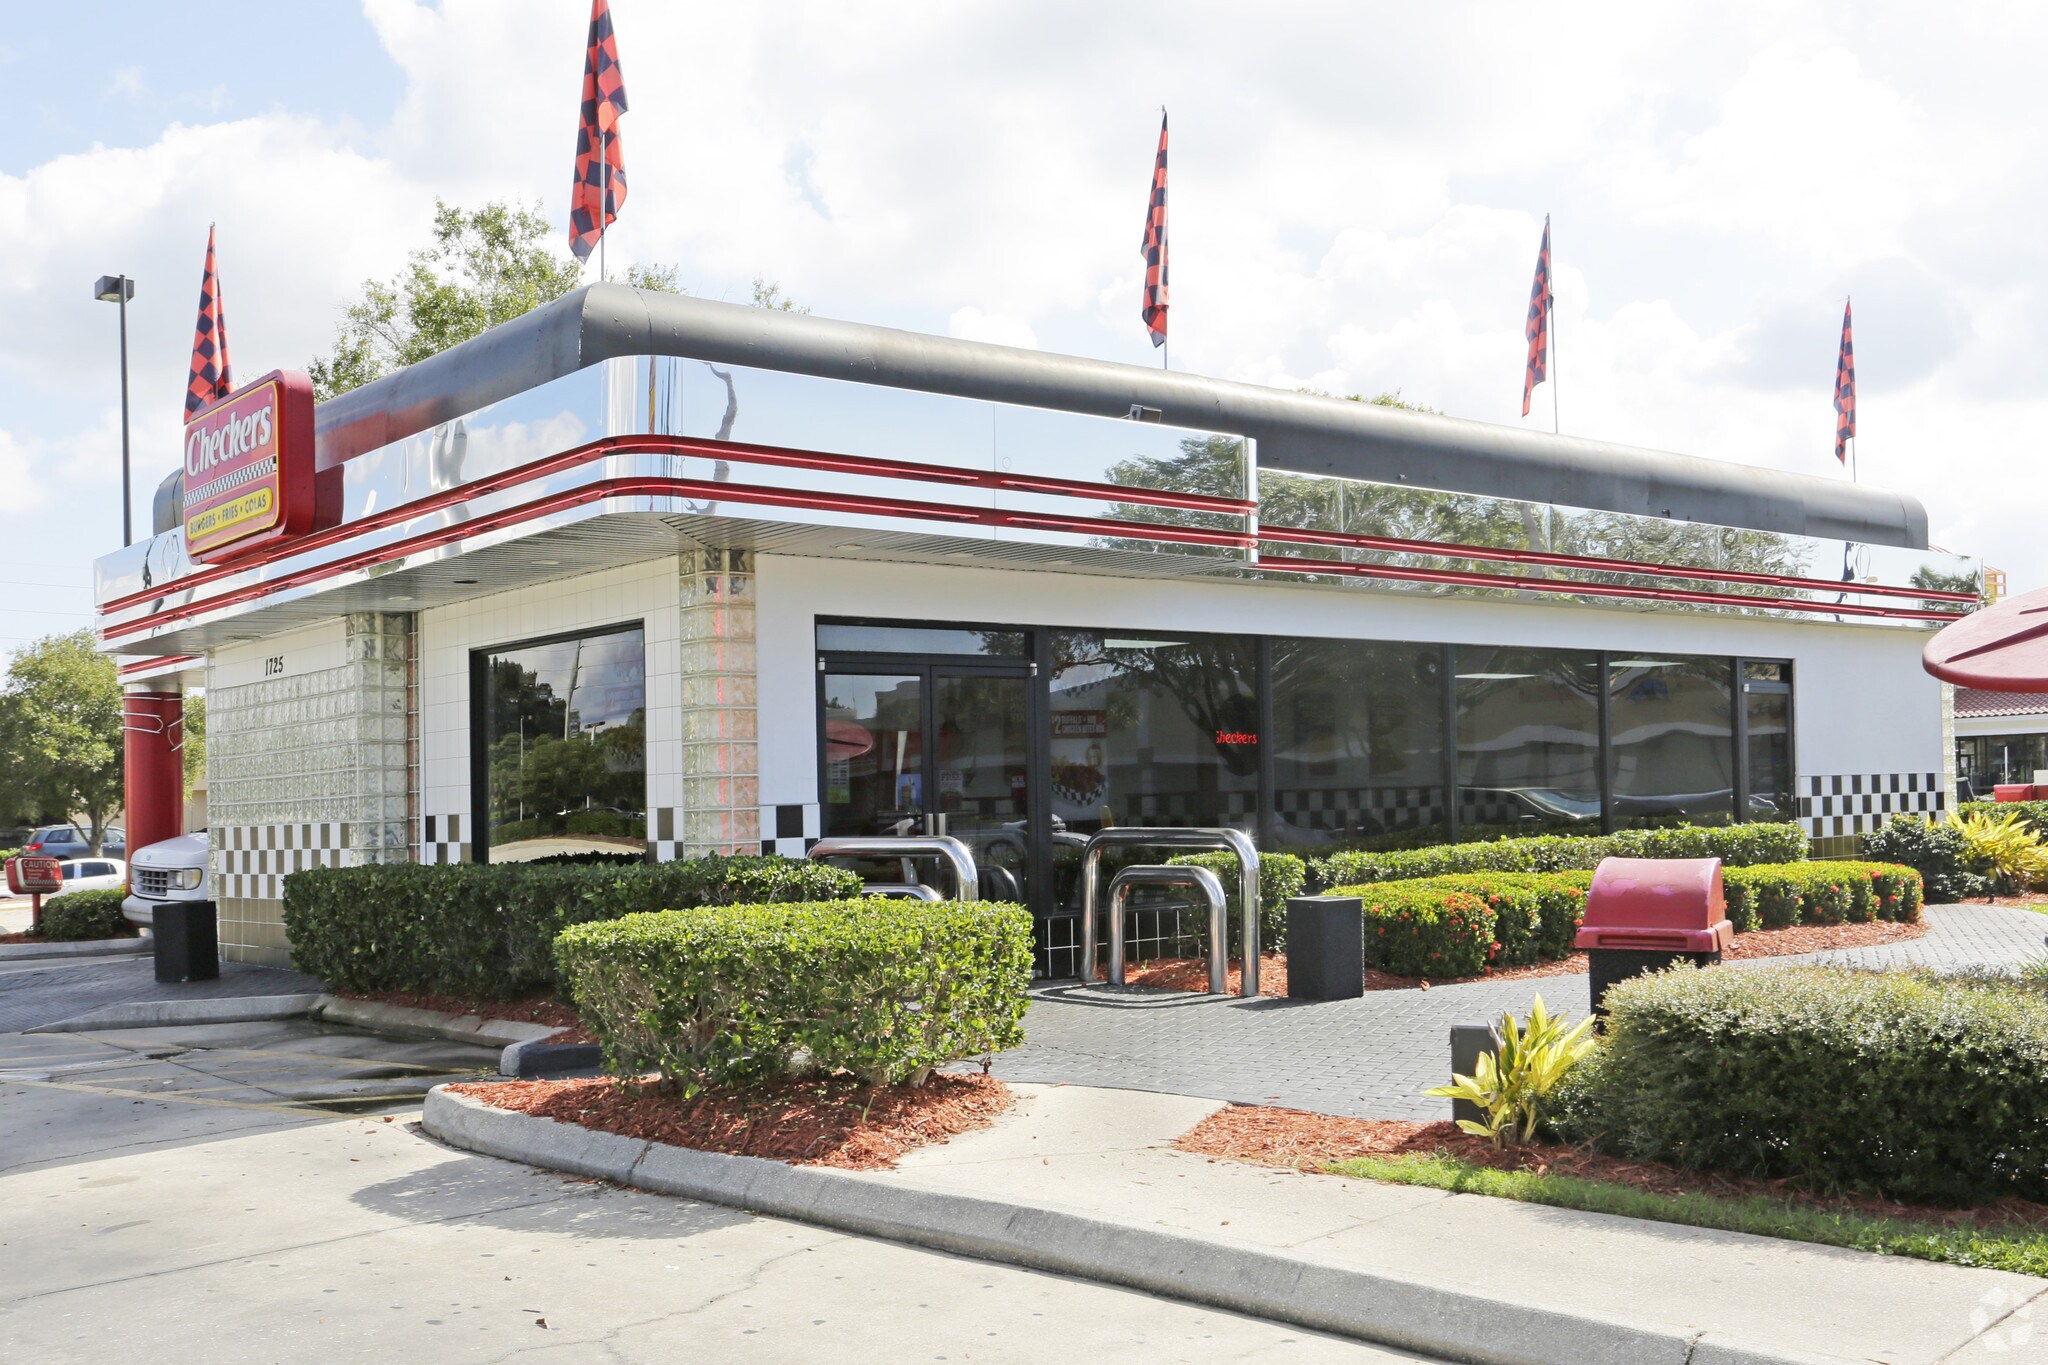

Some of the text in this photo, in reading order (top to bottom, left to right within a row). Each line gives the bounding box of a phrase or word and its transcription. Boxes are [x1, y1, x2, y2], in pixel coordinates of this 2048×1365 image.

[186, 405, 272, 477] Checkers
[190, 494, 267, 535] BURGERS FRIES COLAS
[265, 655, 284, 676] 1725
[23, 860, 58, 869] CAUTION
